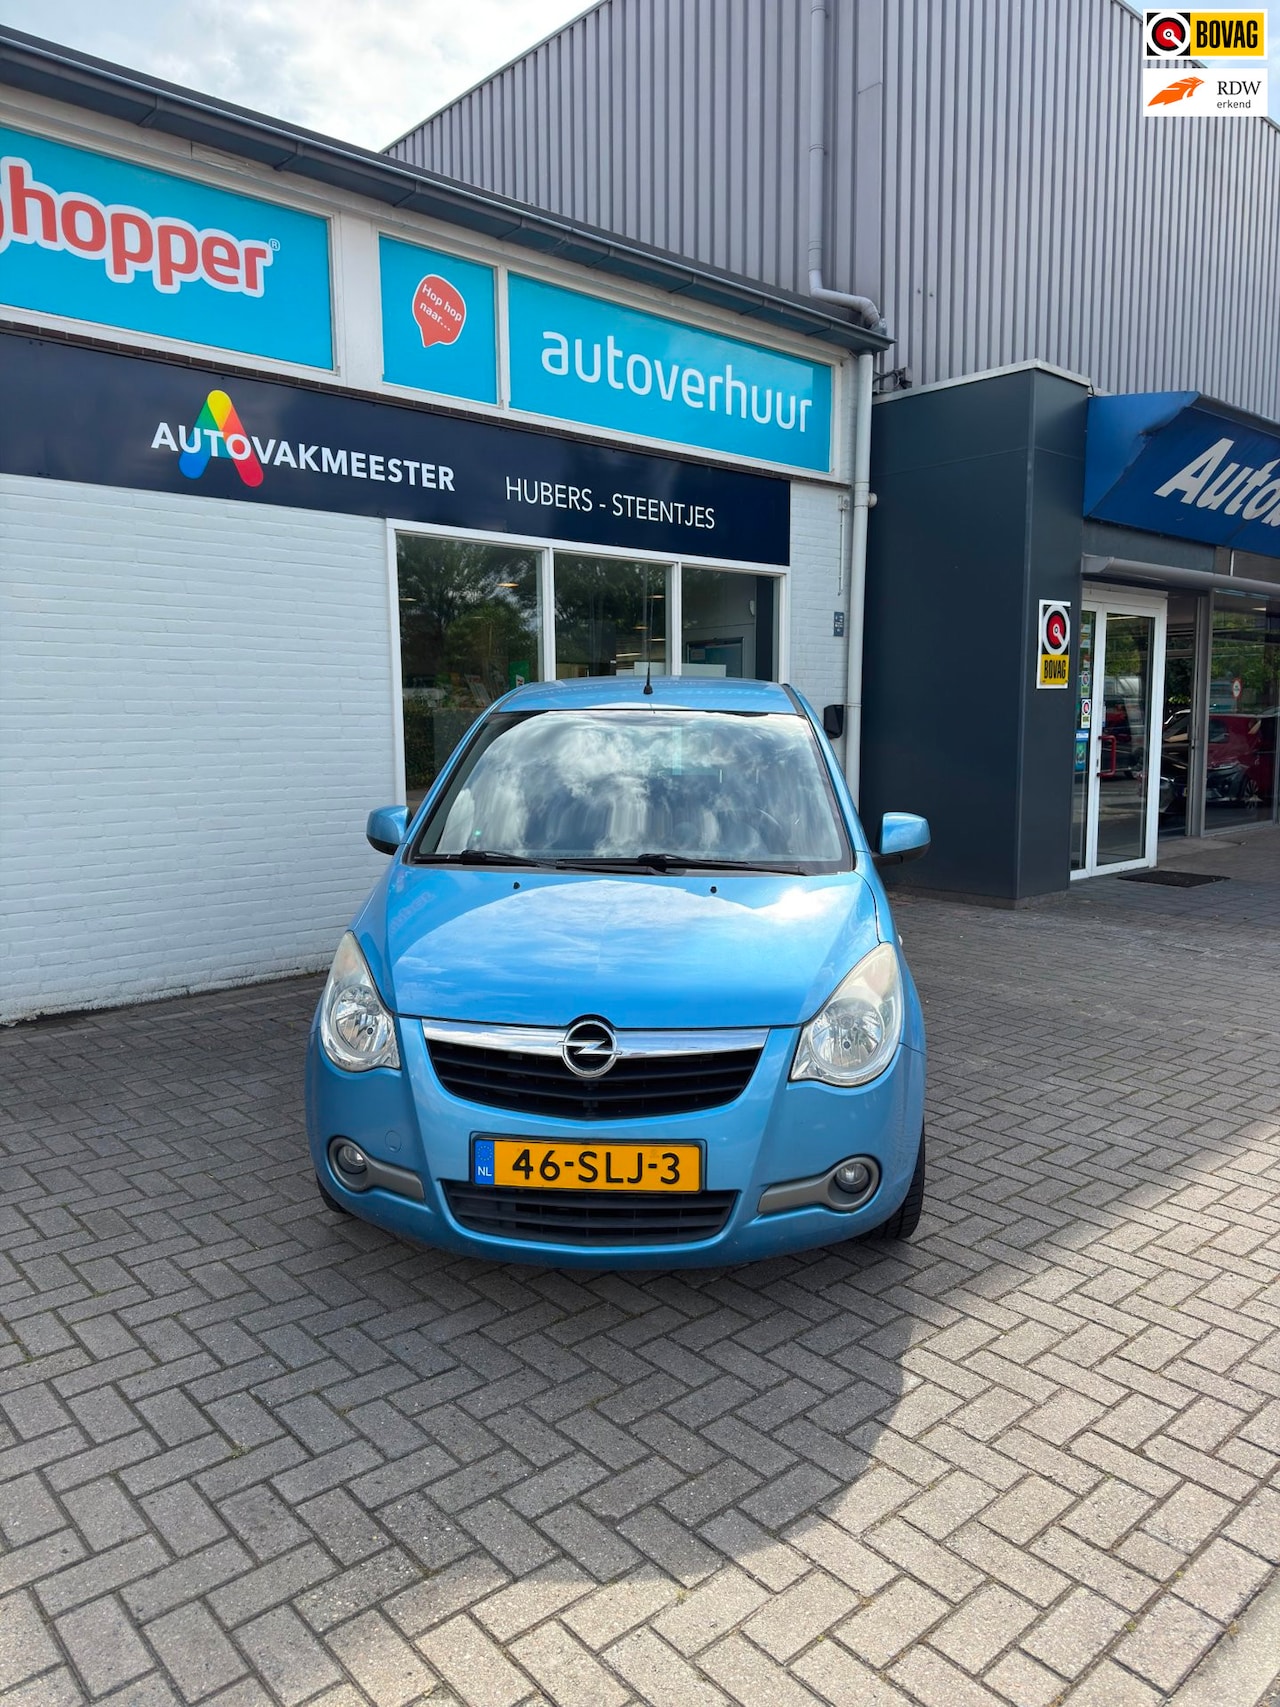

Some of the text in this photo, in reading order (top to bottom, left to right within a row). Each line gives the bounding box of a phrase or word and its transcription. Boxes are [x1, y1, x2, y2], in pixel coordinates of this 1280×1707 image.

[0, 165, 268, 290] hopper
[420, 302, 451, 332] naar...
[422, 284, 463, 322] Hop hop
[541, 331, 813, 433] autoverhuur
[151, 422, 455, 492] AUTOVAKMEESTER
[506, 476, 593, 513] HUBERS
[612, 493, 716, 530] STEENTJES
[1153, 437, 1280, 527] Auto
[1044, 659, 1067, 679] BOVAG
[477, 1165, 493, 1178] NL
[511, 1148, 681, 1185] 46-SLJ-3
